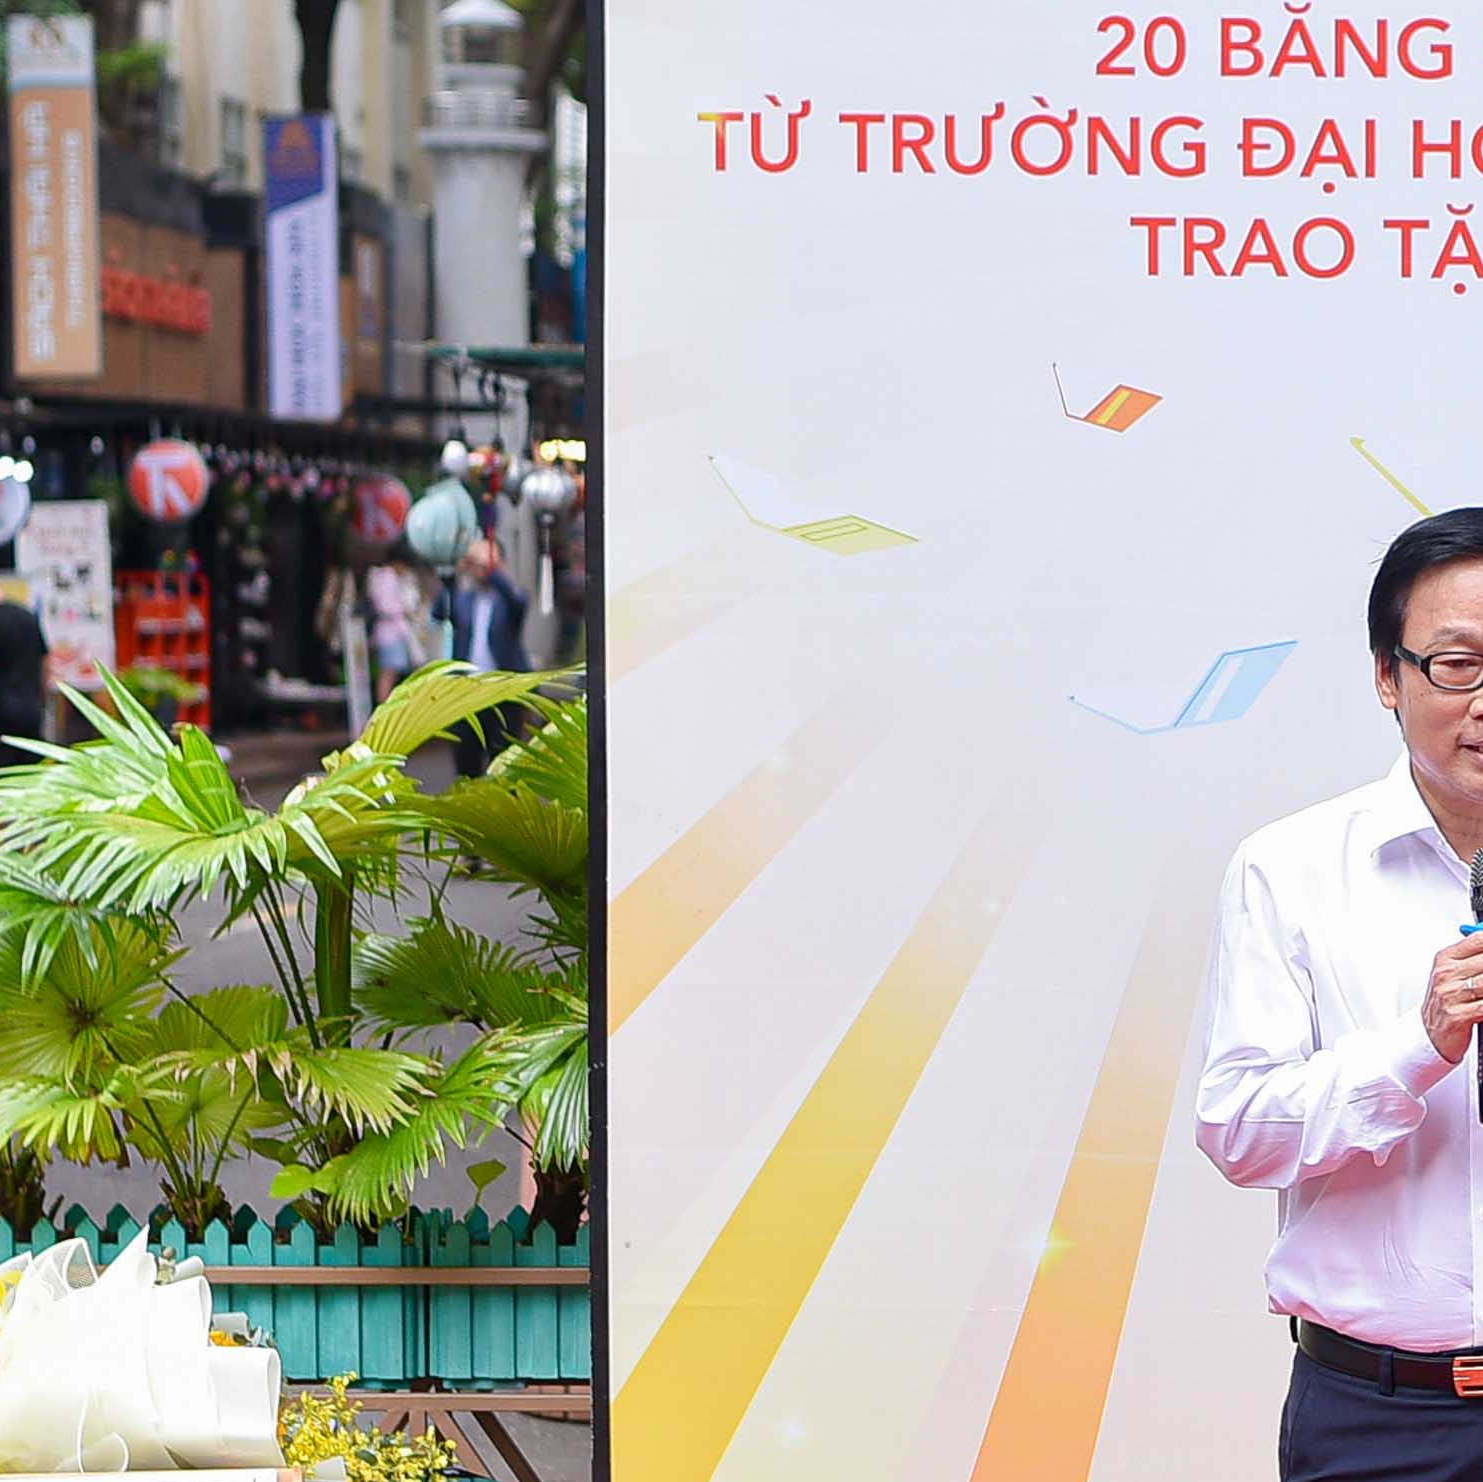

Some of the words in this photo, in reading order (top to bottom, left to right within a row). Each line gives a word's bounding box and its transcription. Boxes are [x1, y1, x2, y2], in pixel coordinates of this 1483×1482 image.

[1095, 15, 1187, 77] 20
[1220, 1, 1454, 78] BĂNG
[697, 94, 813, 173] TỪ
[839, 95, 1207, 177] TRƯỜNG
[1236, 117, 1377, 194] ĐẠI
[1129, 216, 1356, 279] TRAO
